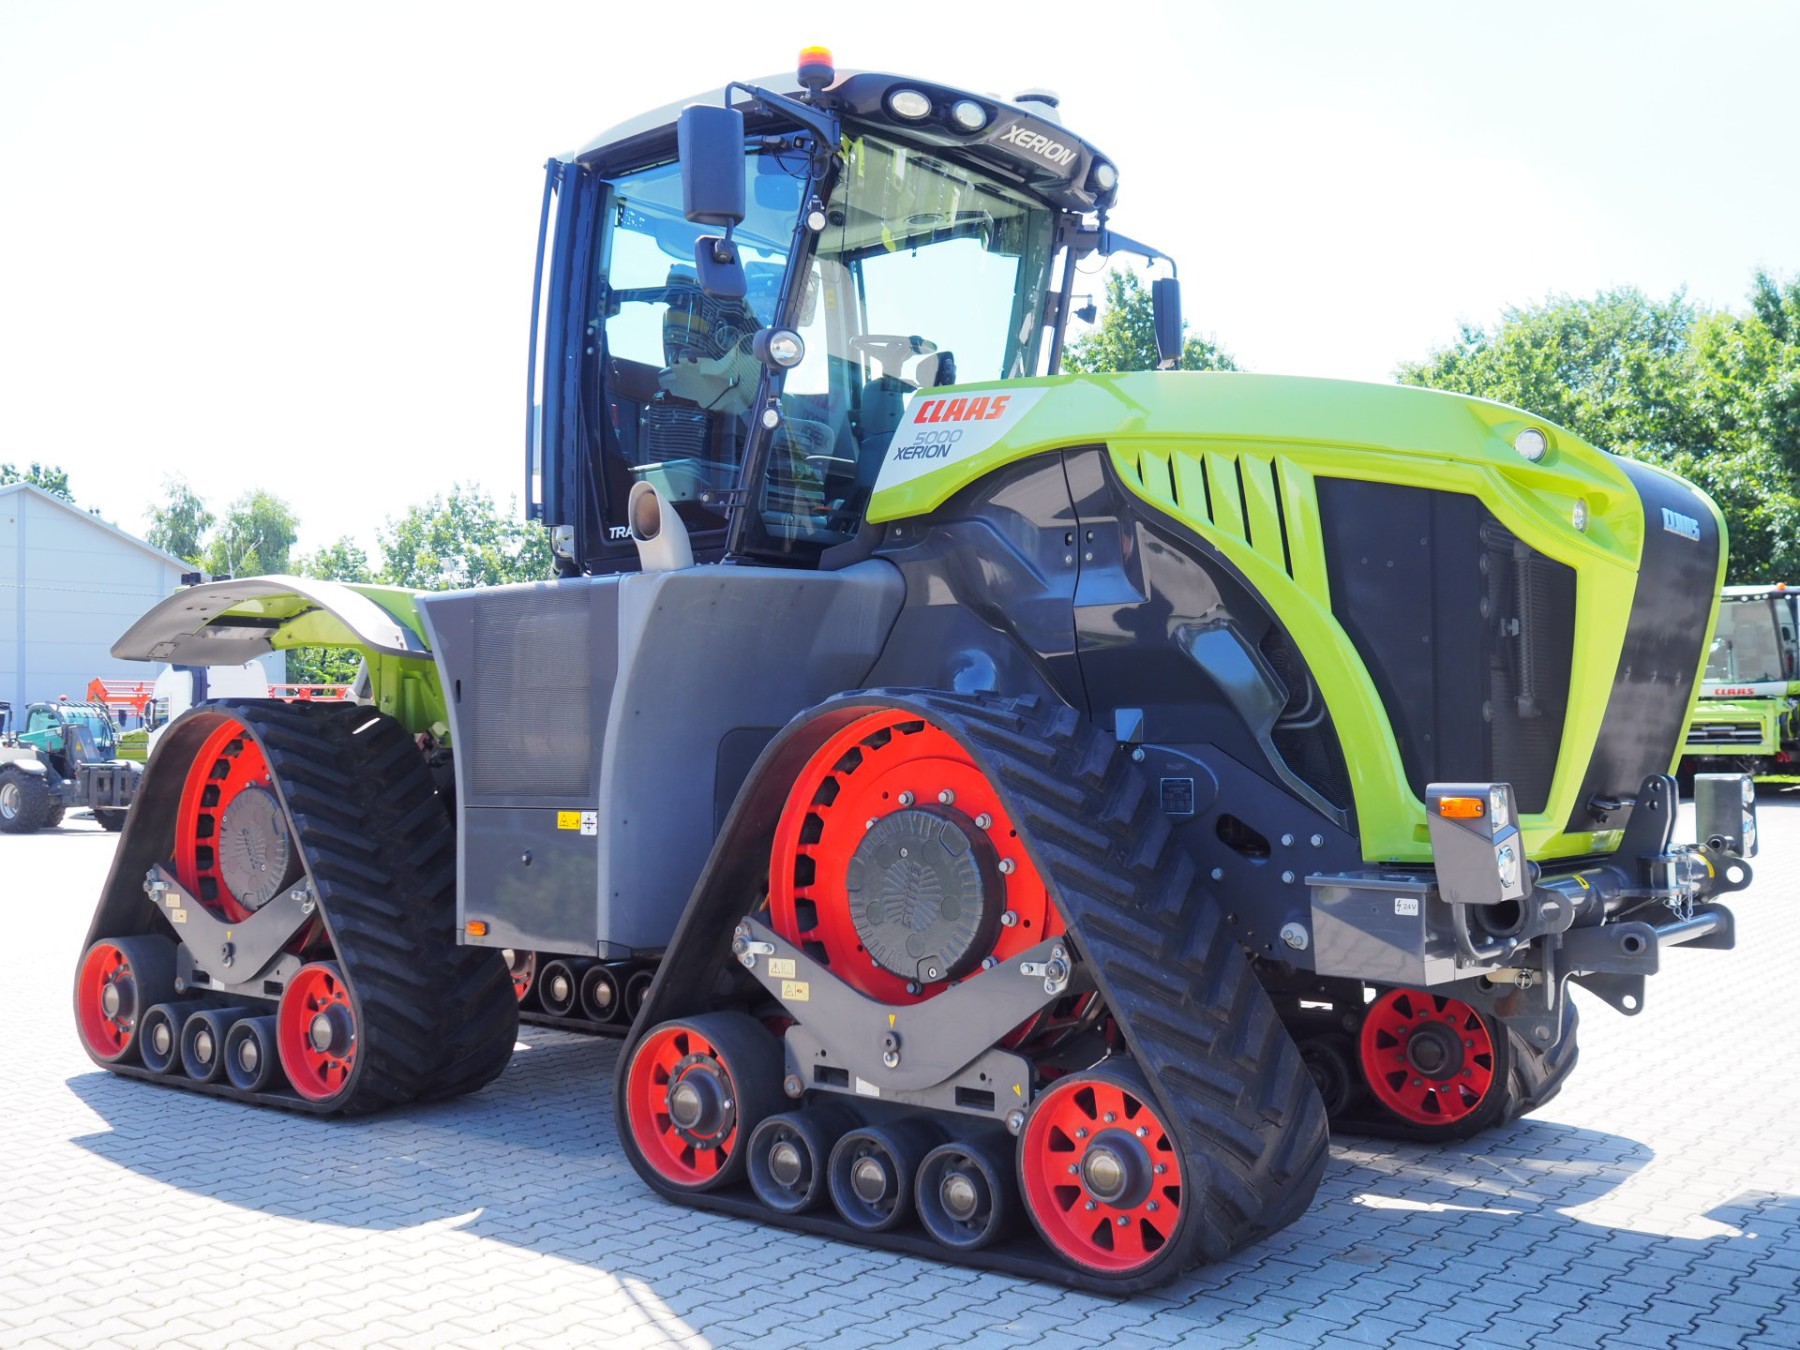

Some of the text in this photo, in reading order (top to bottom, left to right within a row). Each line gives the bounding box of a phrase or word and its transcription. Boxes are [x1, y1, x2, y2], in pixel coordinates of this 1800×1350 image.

[1000, 125, 1077, 166] XERION
[913, 395, 1012, 425] CLAAS
[913, 428, 964, 446] 5000
[893, 443, 952, 461] XERION
[609, 526, 634, 539] TRA
[1714, 688, 1755, 696] CLAAS
